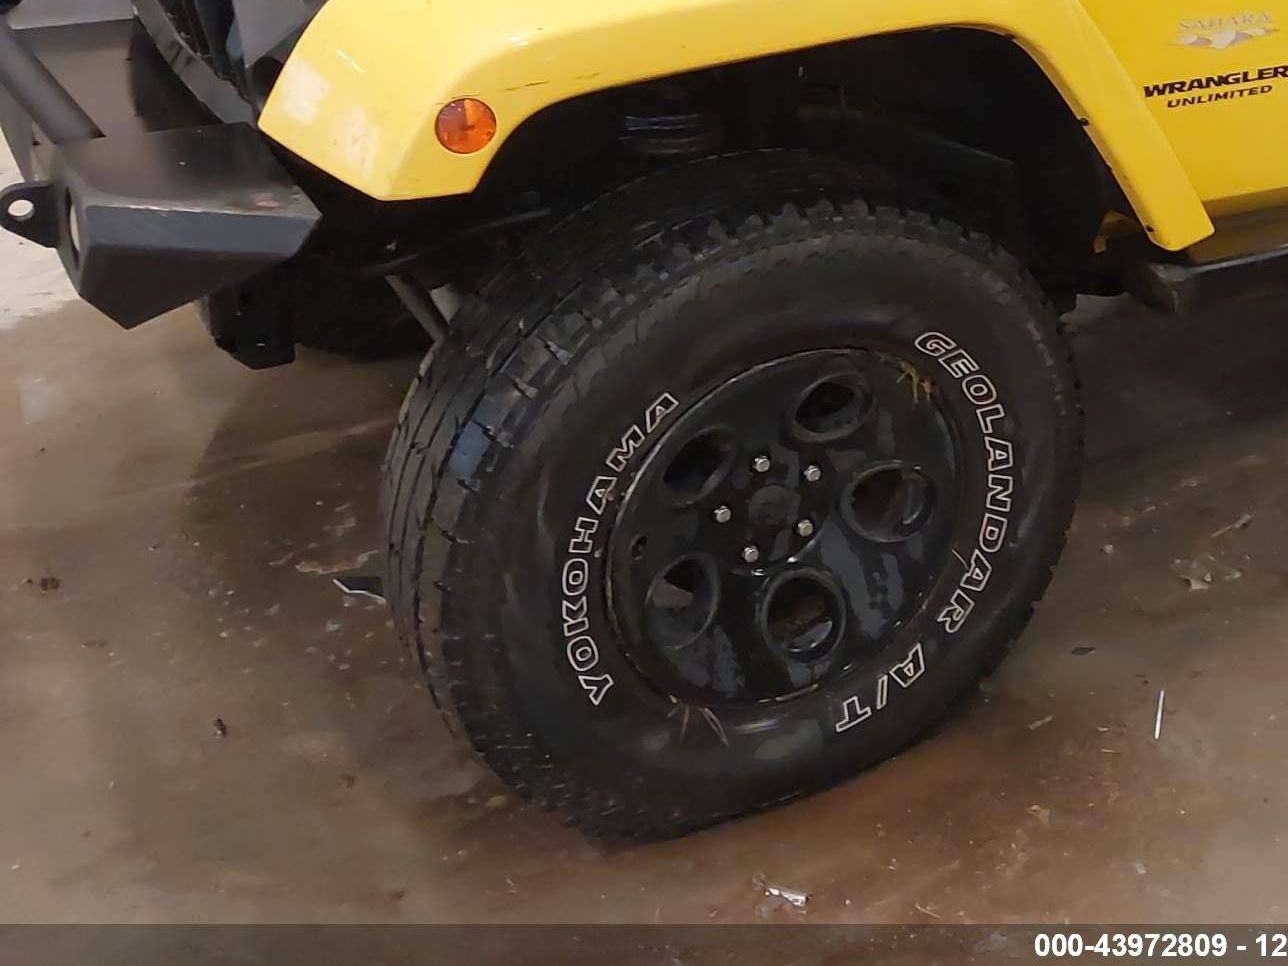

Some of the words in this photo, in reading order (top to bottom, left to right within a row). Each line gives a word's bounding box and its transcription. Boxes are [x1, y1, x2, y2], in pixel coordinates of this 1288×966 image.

[1178, 11, 1272, 30] SAHARA
[1167, 85, 1272, 108] UNLIMITED
[914, 331, 1014, 634] GEOLANDAR
[562, 393, 679, 705] YOKOHAMA
[835, 643, 926, 733] A/T
